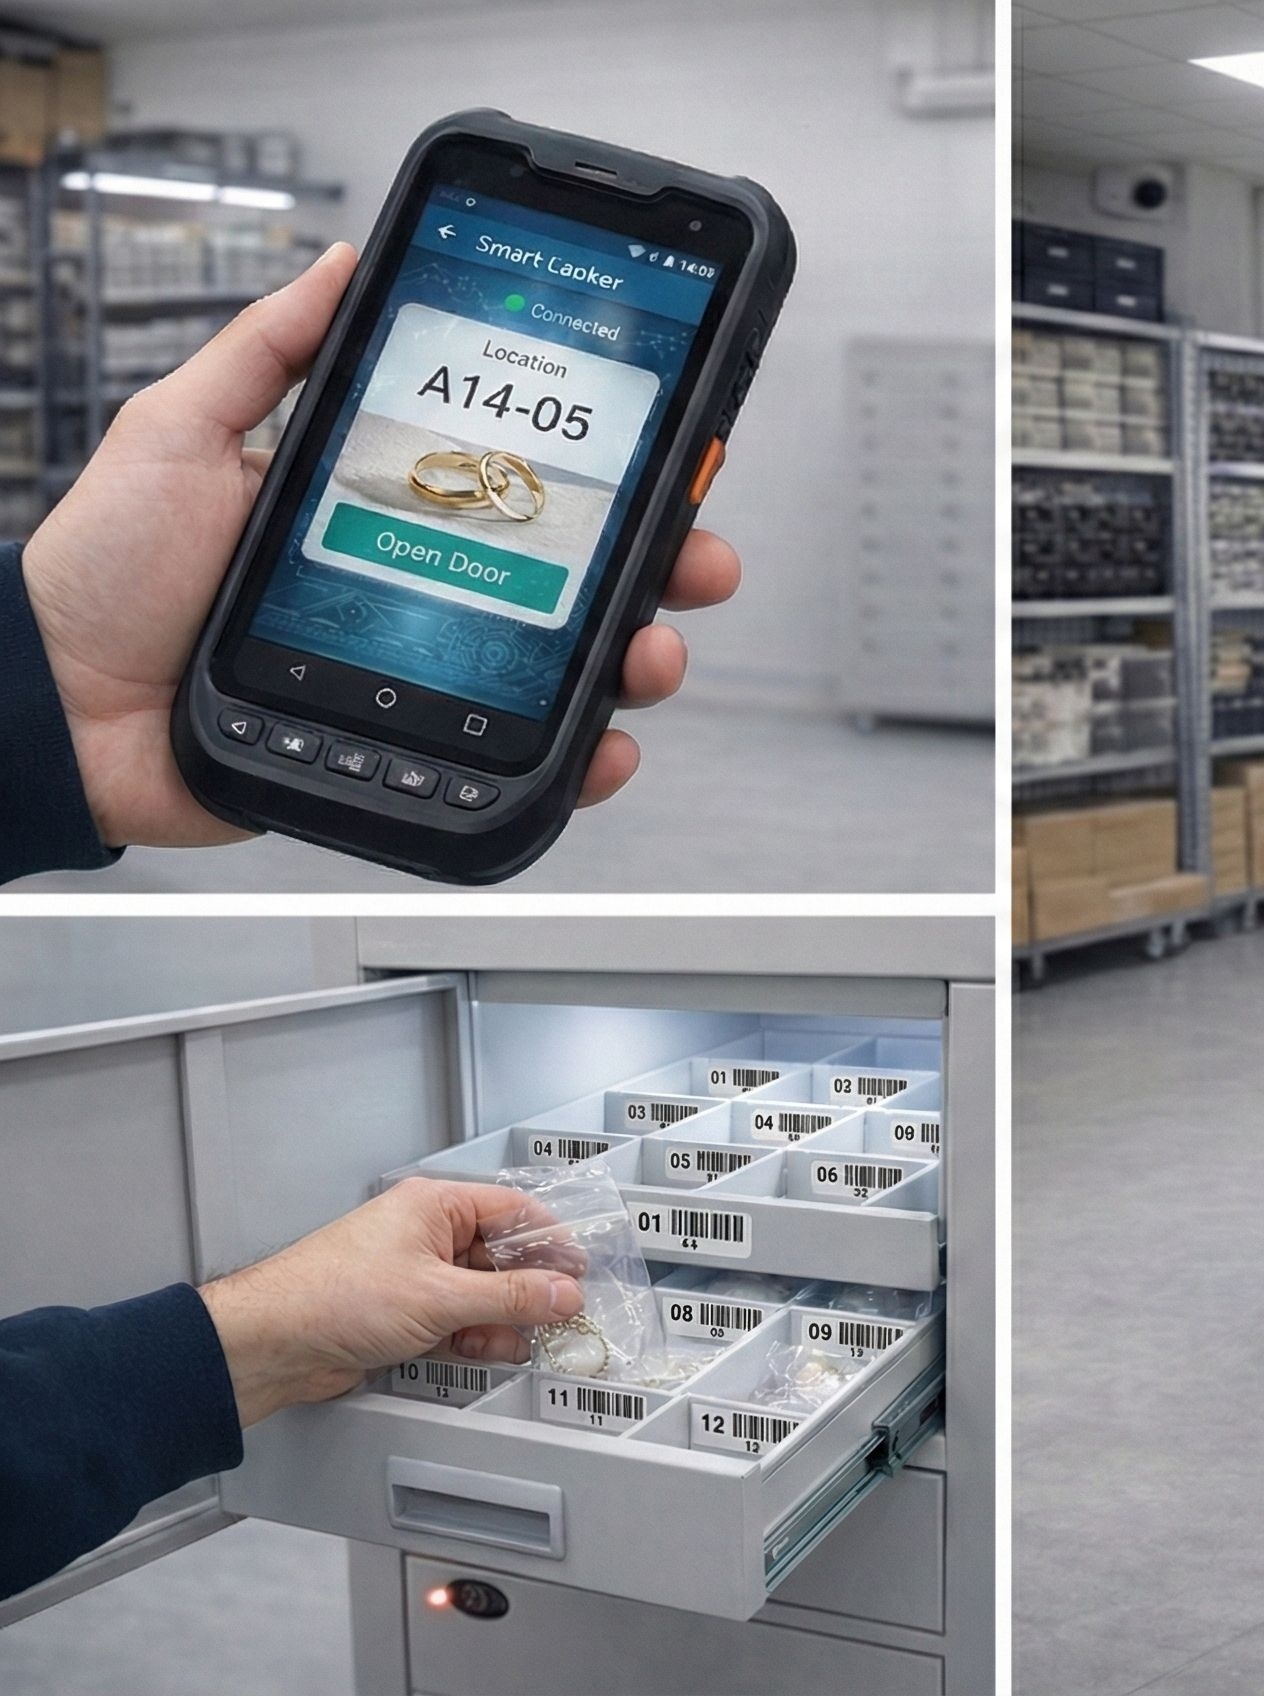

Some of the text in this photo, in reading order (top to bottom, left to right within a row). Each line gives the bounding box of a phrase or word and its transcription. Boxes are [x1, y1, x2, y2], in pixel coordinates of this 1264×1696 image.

[476, 234, 545, 268] Smart
[482, 339, 568, 379] Location
[416, 365, 593, 441] A14-05
[376, 531, 511, 585] Open Door
[711, 1070, 726, 1084] 01
[628, 1105, 646, 1119] 03
[755, 1114, 773, 1130] 04
[533, 1141, 552, 1156] 04
[670, 1153, 691, 1169] 05
[817, 1166, 838, 1182] 06
[638, 1212, 660, 1233] 01
[670, 1304, 693, 1322] 08
[808, 1323, 832, 1341] 09
[400, 1363, 419, 1380] 10
[548, 1388, 568, 1406] 11
[590, 1414, 602, 1426] 11
[702, 1413, 725, 1434] 12
[745, 1441, 760, 1453] 12
